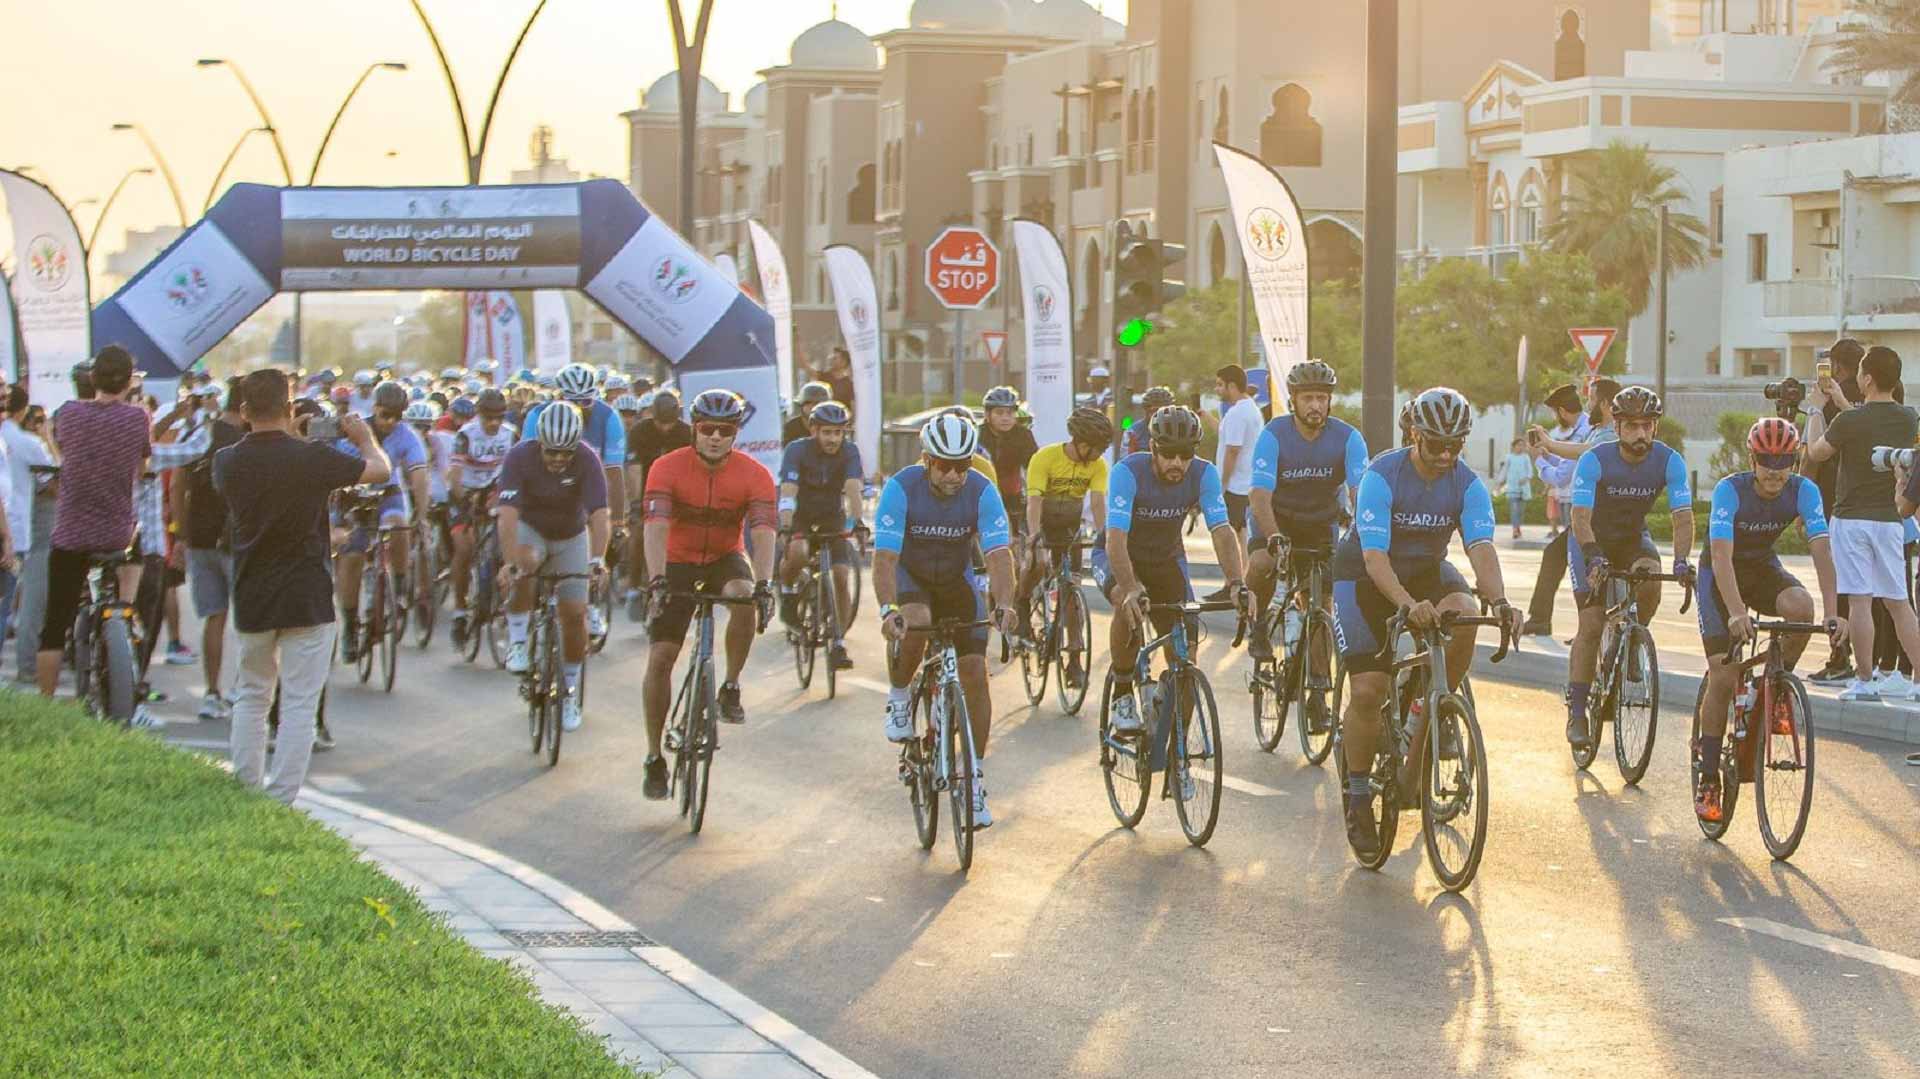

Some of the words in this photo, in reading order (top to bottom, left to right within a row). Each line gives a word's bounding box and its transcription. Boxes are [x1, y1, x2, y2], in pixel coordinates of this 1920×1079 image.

[343, 248, 409, 263] WORLD
[412, 247, 481, 262] BICYCLE
[485, 246, 521, 261] DAY
[937, 269, 988, 290] STOP
[1281, 467, 1334, 479] SHARJAH
[1606, 486, 1657, 497] SHARJAH
